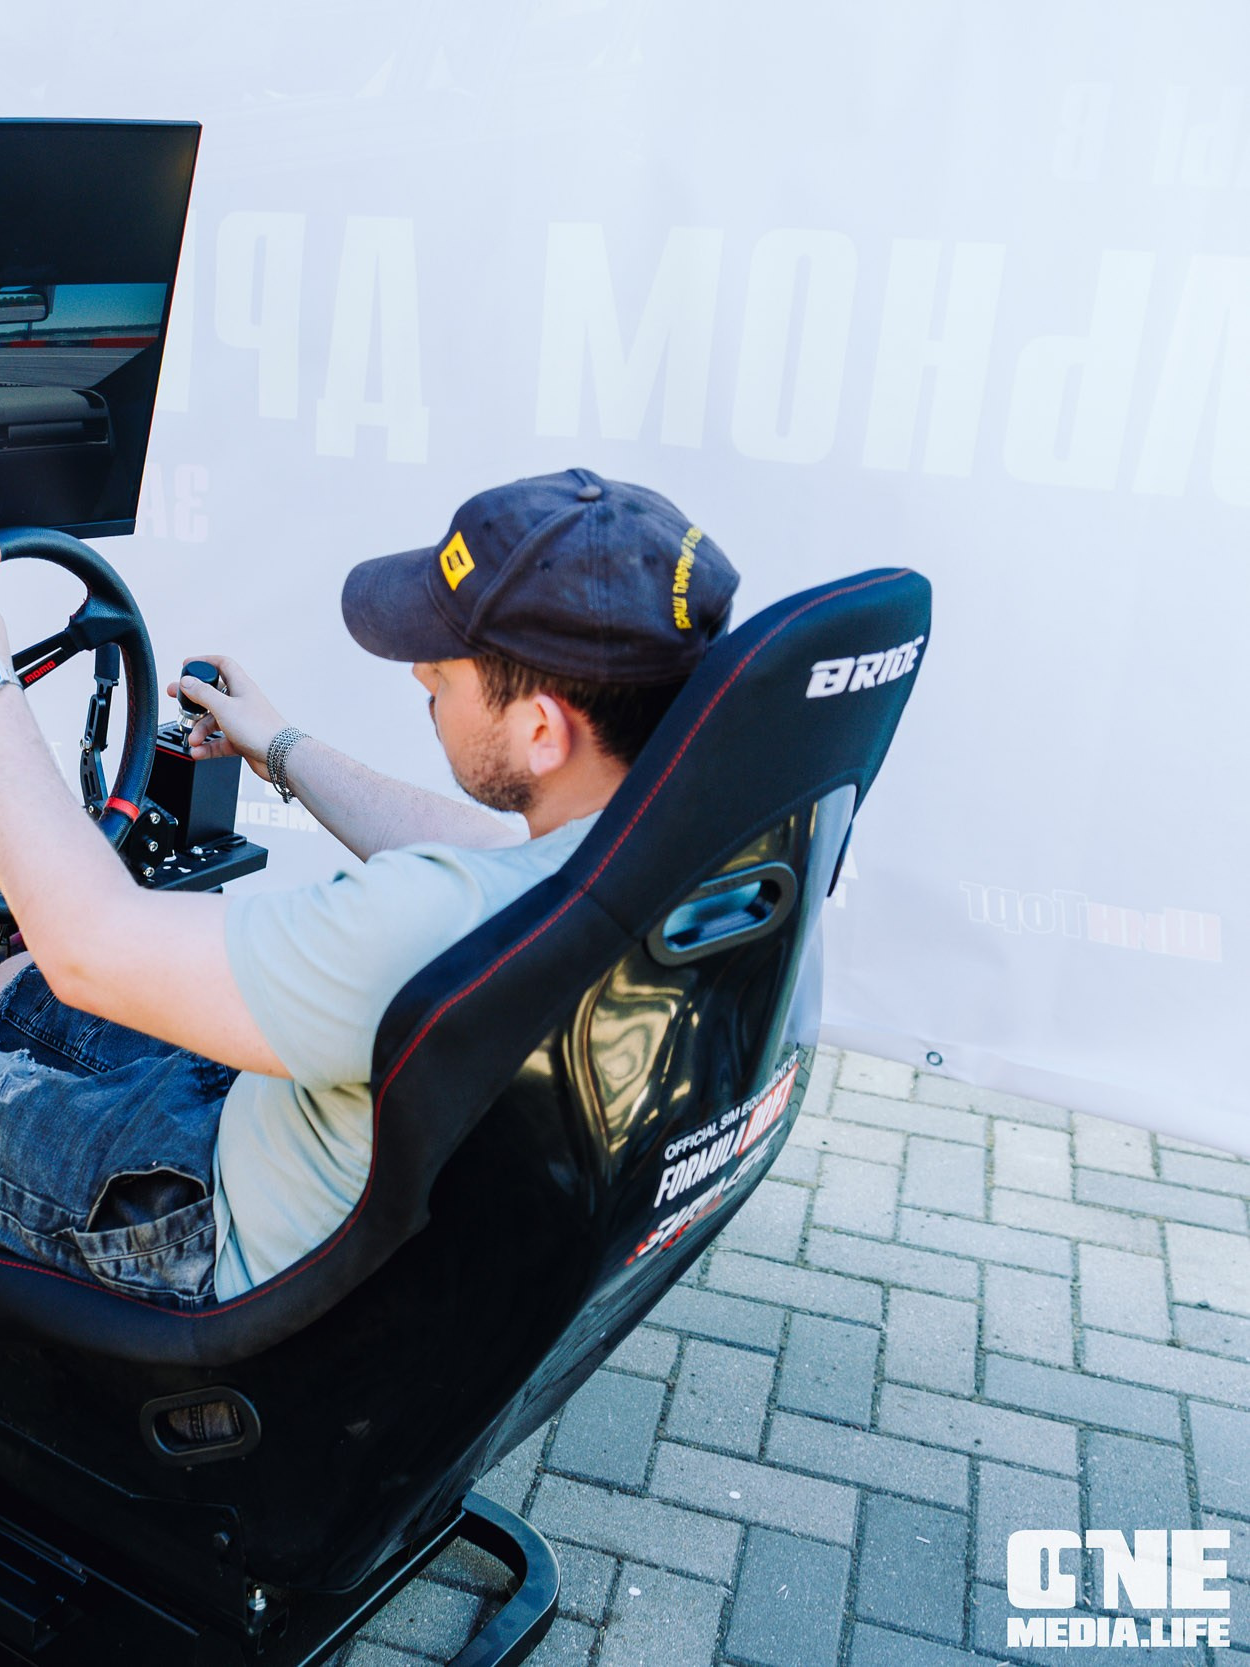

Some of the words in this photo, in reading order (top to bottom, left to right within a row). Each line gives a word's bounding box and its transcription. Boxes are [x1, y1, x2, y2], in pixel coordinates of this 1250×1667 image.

[806, 635, 925, 699] BRIDE
[653, 1120, 748, 1208] FORMULA
[742, 1065, 797, 1152] DRIFT
[664, 1121, 718, 1161] OFFICIAL
[719, 1106, 740, 1130] SIM
